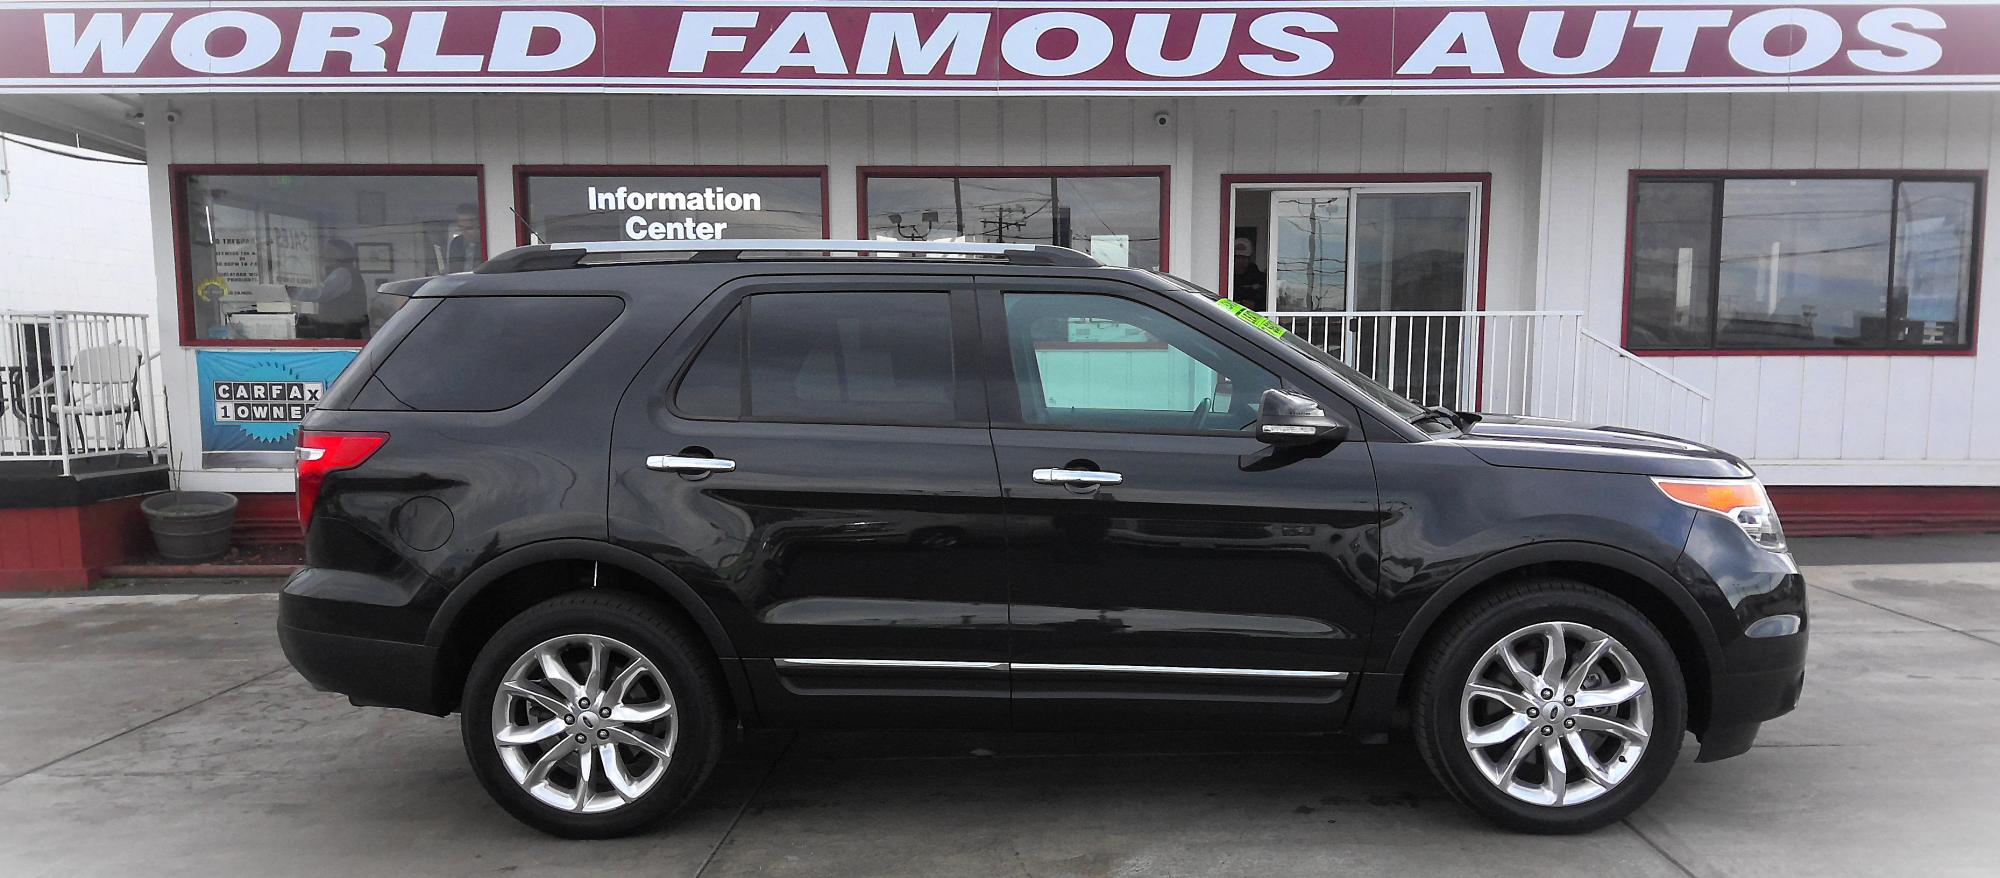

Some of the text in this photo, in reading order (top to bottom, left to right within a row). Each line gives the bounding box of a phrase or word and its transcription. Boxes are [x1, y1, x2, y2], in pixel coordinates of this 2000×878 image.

[43, 8, 1947, 77] WORLD FAMOUS AUTOS
[588, 187, 761, 211] Information
[626, 215, 728, 240] Center
[218, 385, 321, 401] CARFAX
